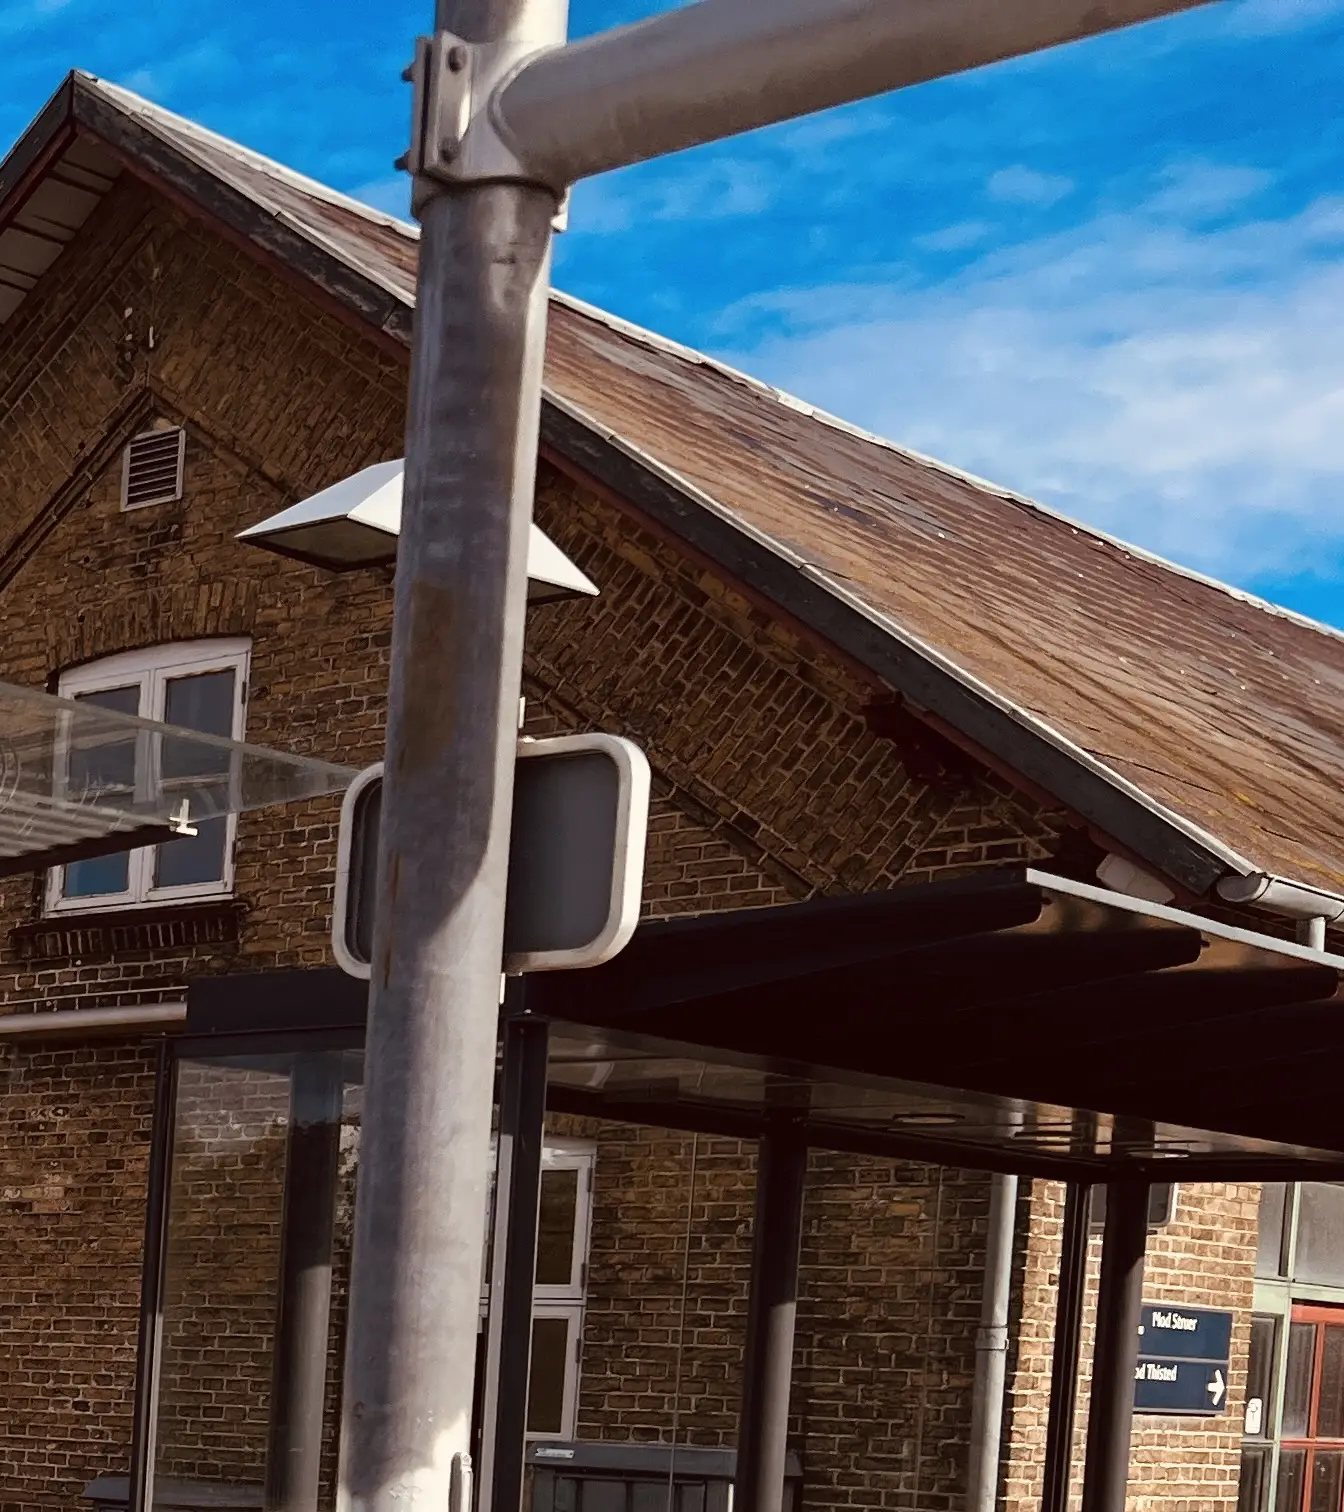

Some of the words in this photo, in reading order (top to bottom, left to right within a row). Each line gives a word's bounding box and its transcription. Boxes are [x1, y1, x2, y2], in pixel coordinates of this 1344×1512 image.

[1152, 1311, 1172, 1328] Mod
[1172, 1313, 1198, 1331] Struer
[1147, 1363, 1178, 1381] Thisted
